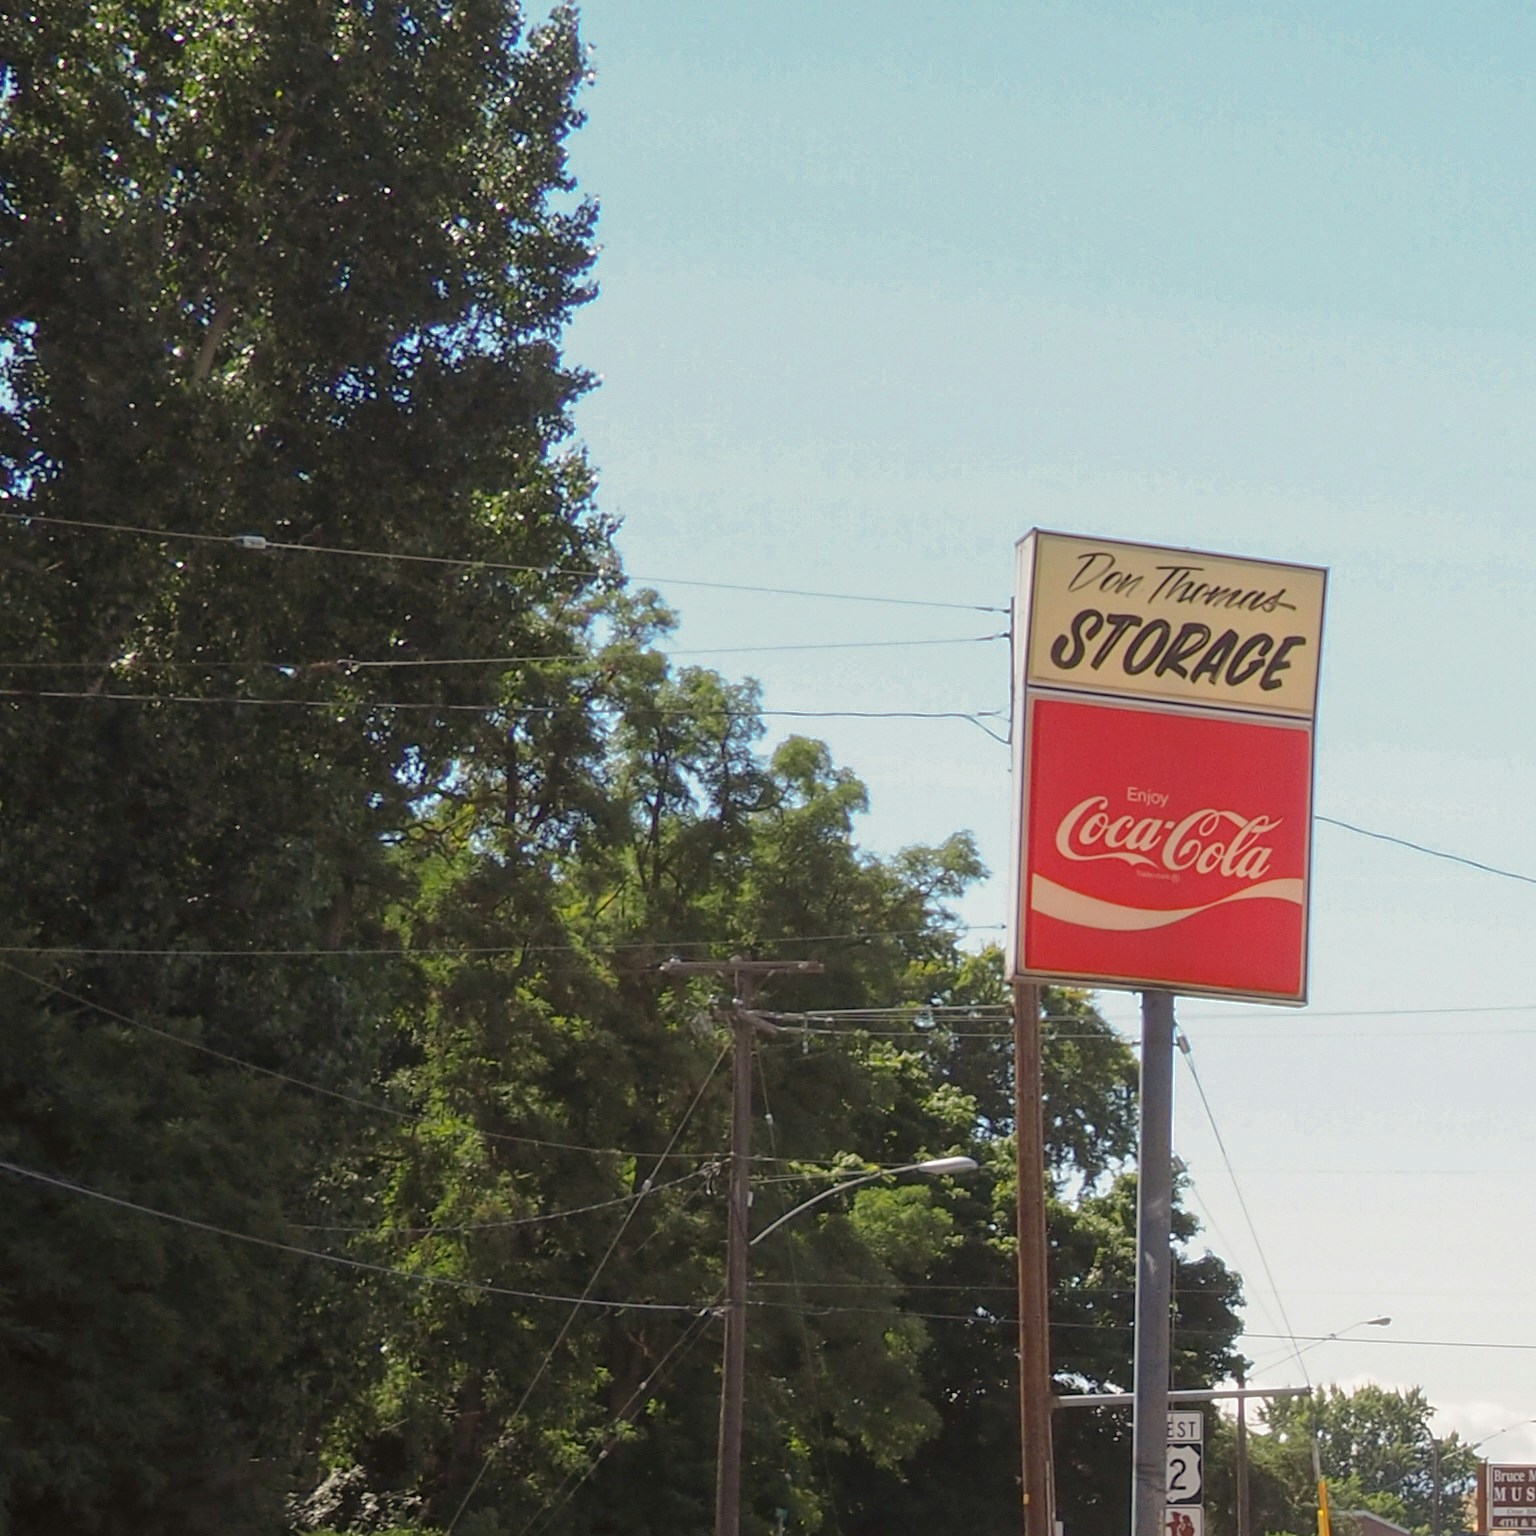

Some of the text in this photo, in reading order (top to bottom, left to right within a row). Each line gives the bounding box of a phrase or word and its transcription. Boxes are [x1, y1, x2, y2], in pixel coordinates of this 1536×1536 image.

[1068, 552, 1297, 613] Don Thomas
[1051, 609, 1306, 691] STORAGE
[1127, 786, 1169, 808] Enjoy
[1056, 796, 1283, 880] Coca-Cola
[1166, 1421, 1197, 1438] EST
[1494, 1469, 1525, 1483] Bruce
